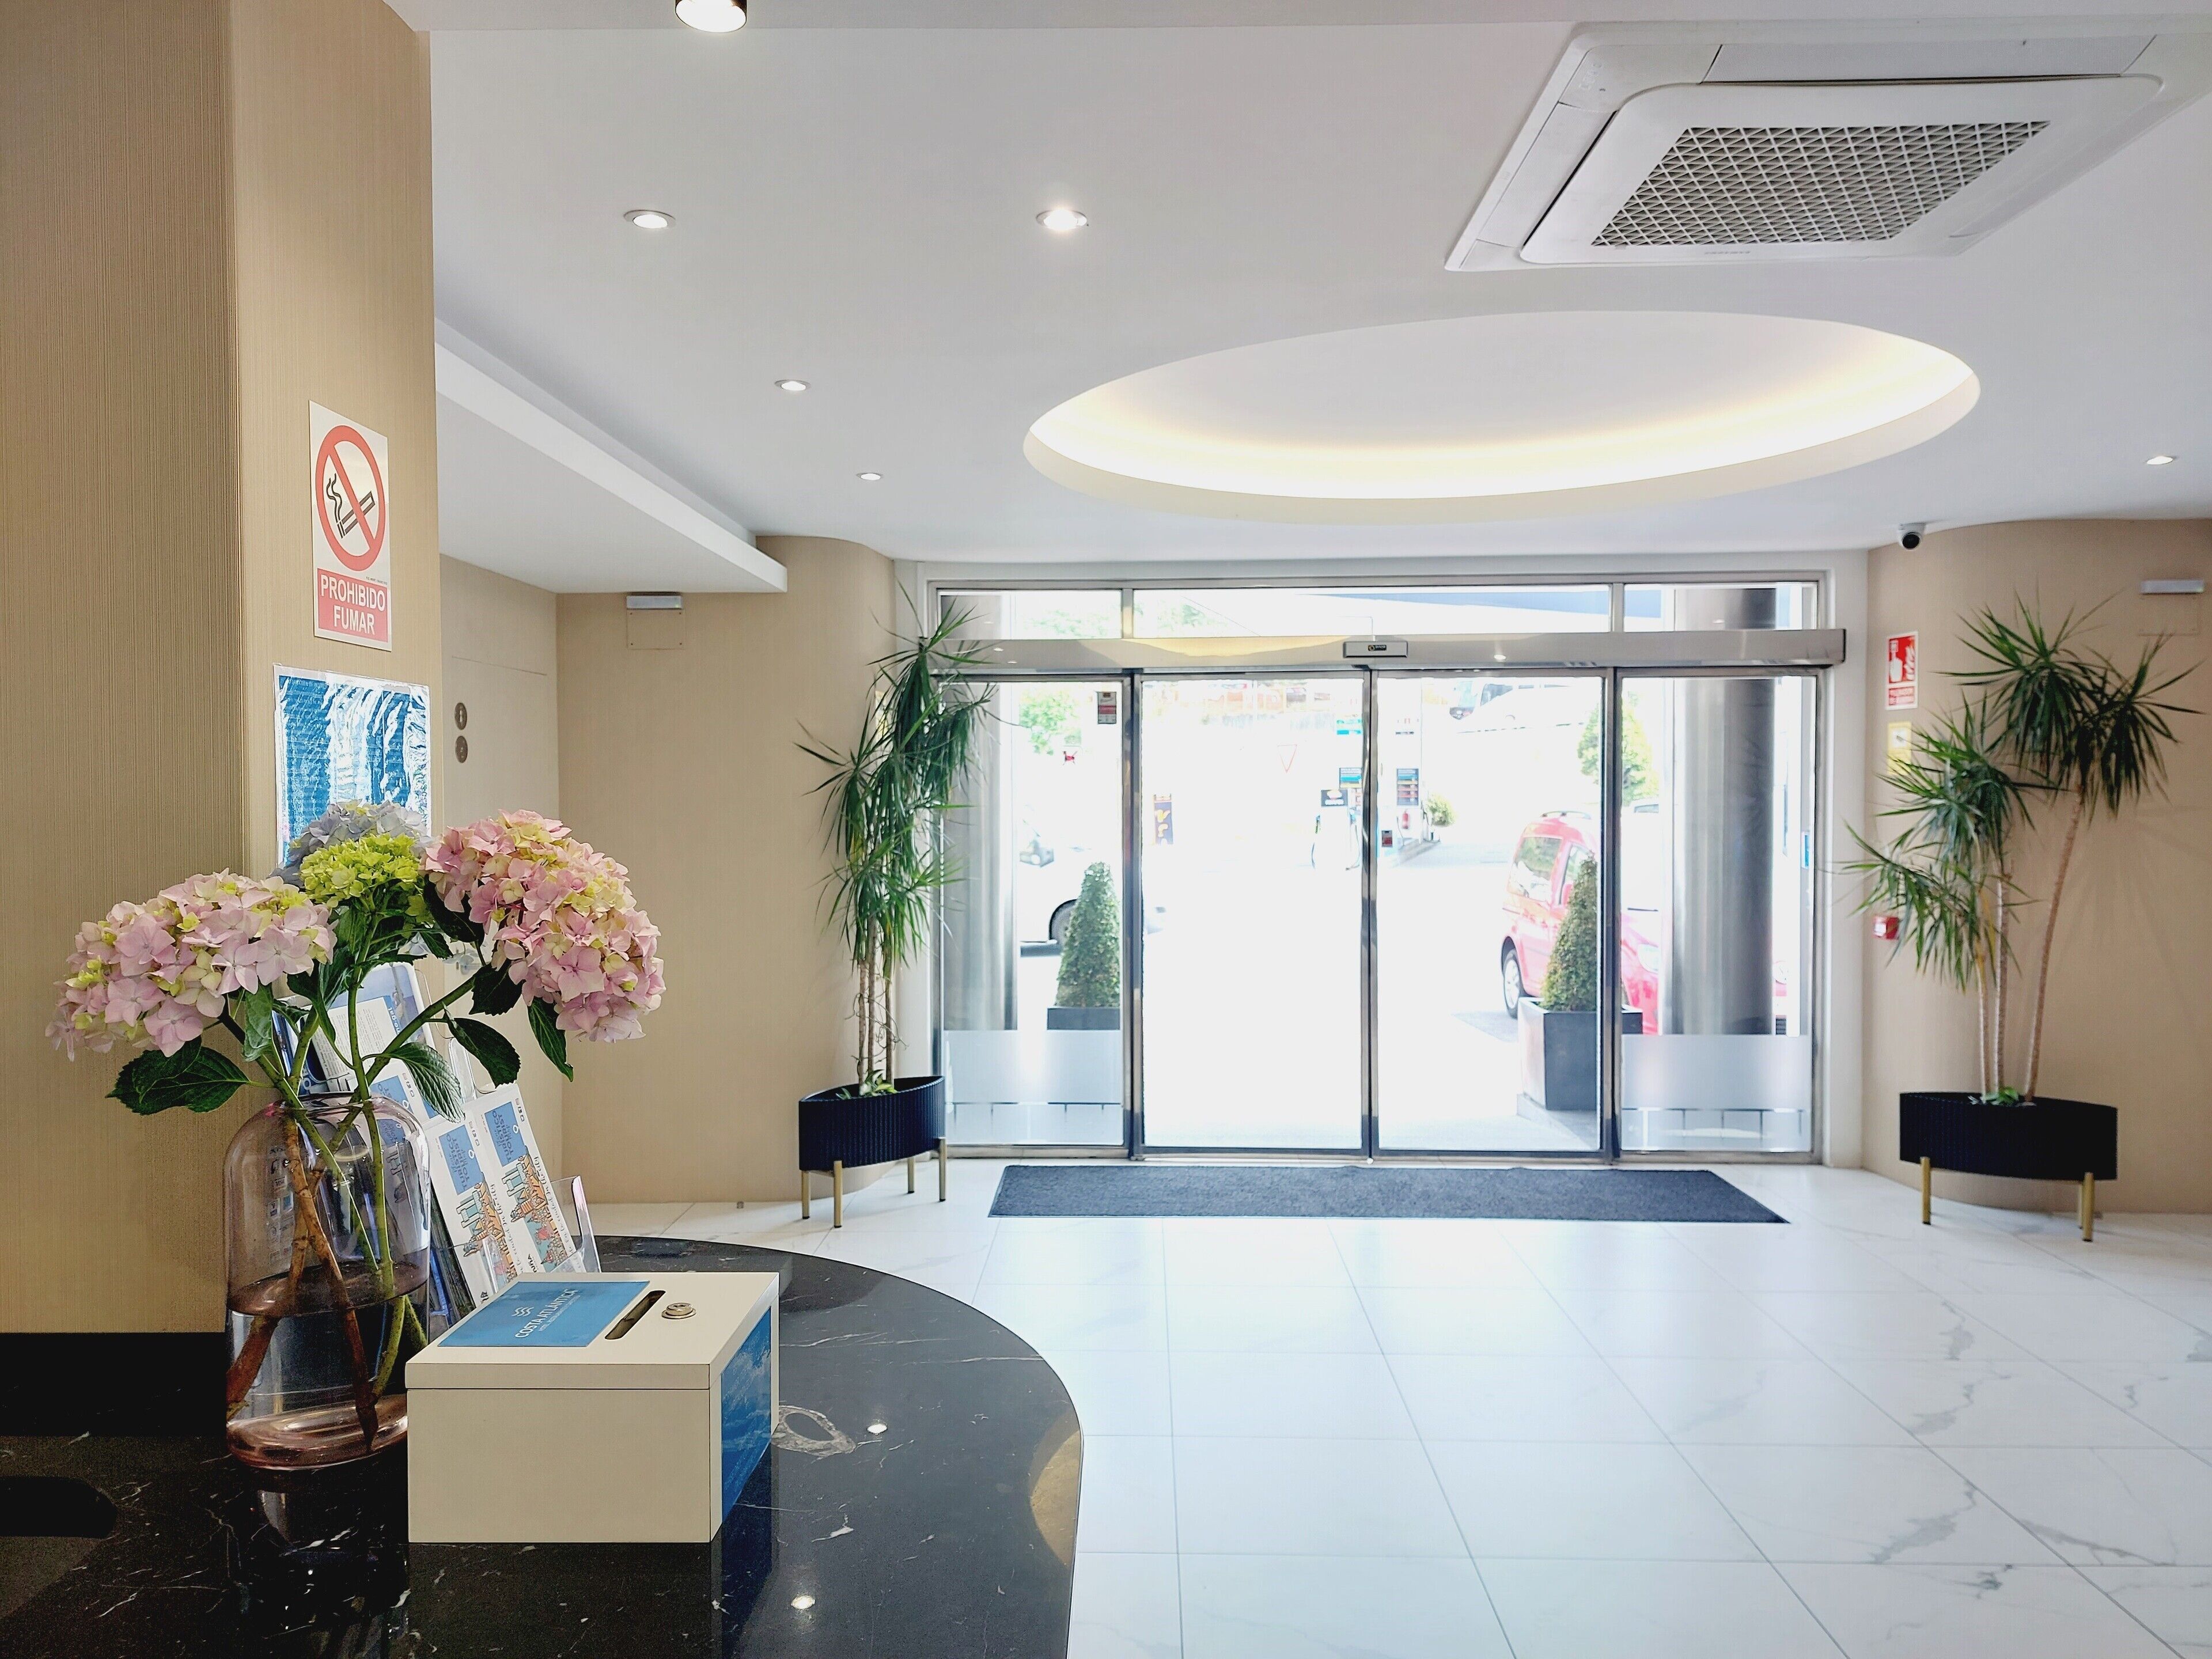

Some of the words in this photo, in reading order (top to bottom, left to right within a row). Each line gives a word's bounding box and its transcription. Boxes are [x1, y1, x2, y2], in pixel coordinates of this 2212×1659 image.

[320, 574, 385, 612] PROHIBIDO
[334, 605, 375, 635] FUMAR
[497, 1113, 514, 1156] TOURIST
[452, 1138, 469, 1181] TOURIST
[515, 1318, 546, 1338] COSTA
[536, 1289, 579, 1318] ATLÁNTICA
